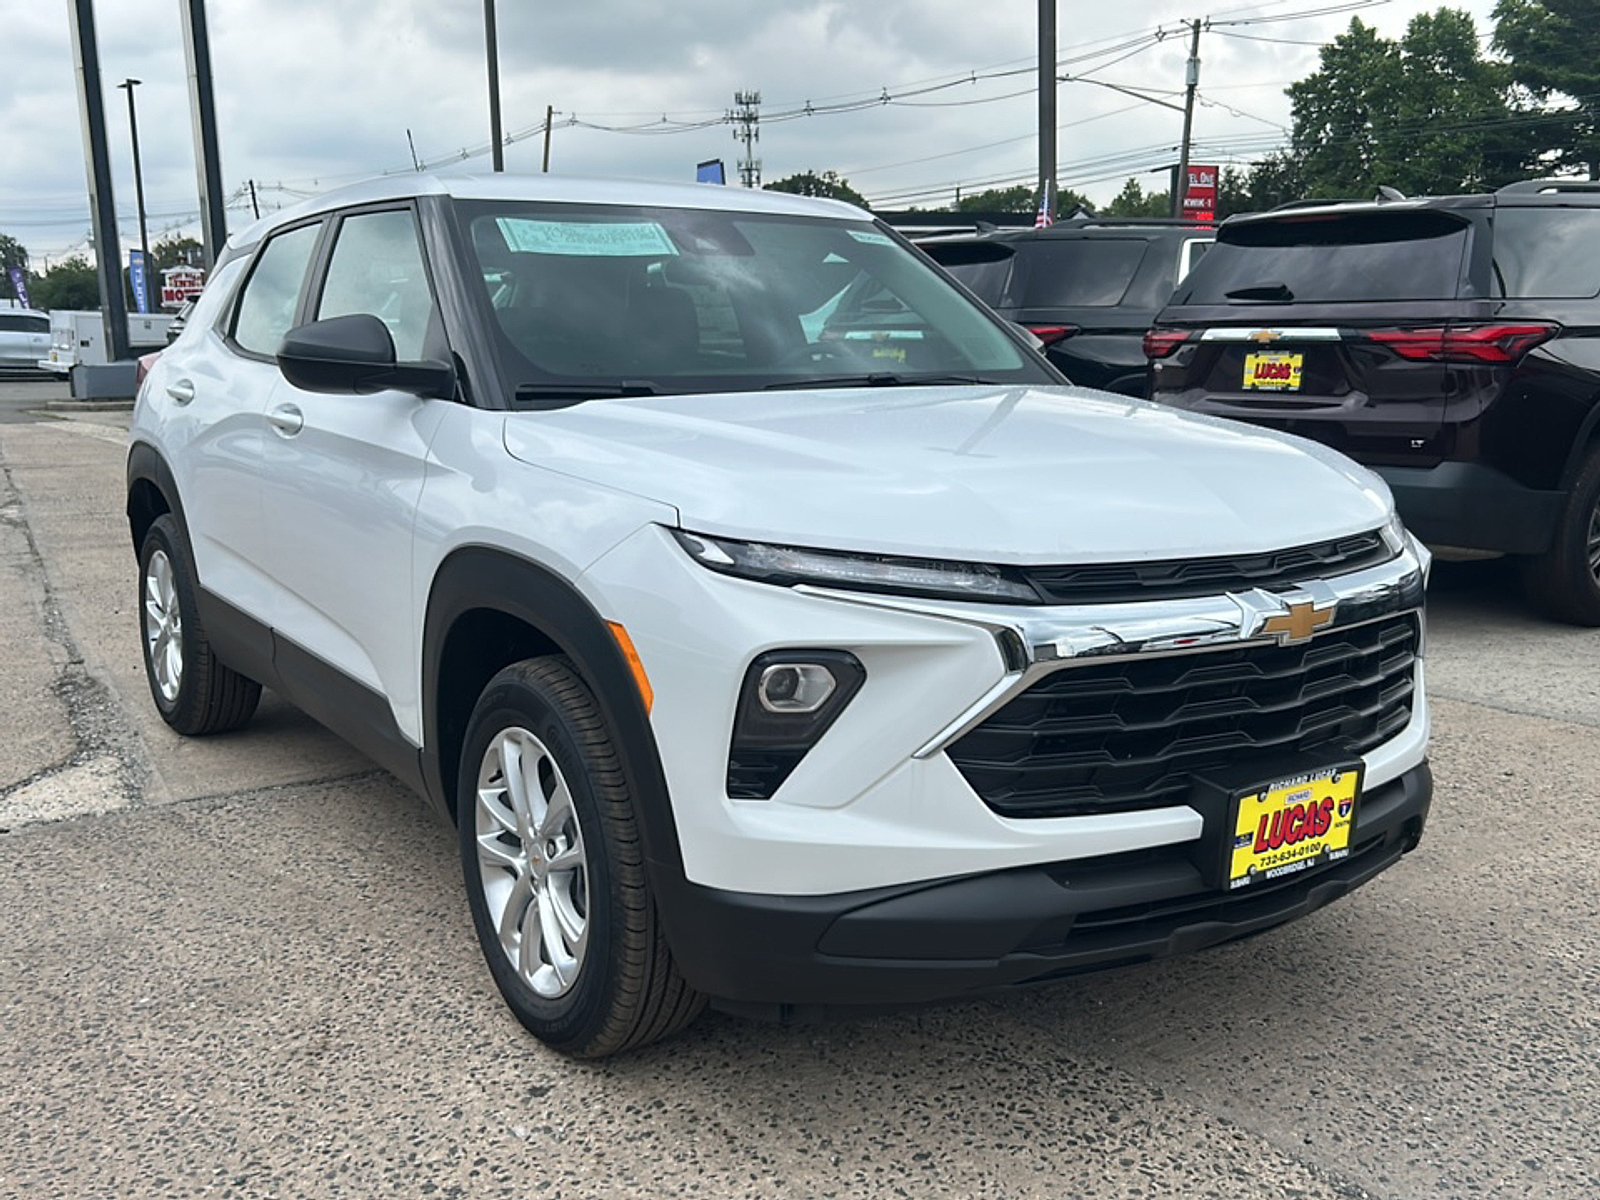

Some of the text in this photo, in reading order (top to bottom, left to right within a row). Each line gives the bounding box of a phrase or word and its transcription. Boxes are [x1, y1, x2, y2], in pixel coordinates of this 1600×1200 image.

[1254, 363, 1291, 379] LUCAS
[1309, 768, 1337, 783] LUCAS
[1254, 797, 1334, 854] LUCAS
[1259, 842, 1321, 868] 732-634-0100
